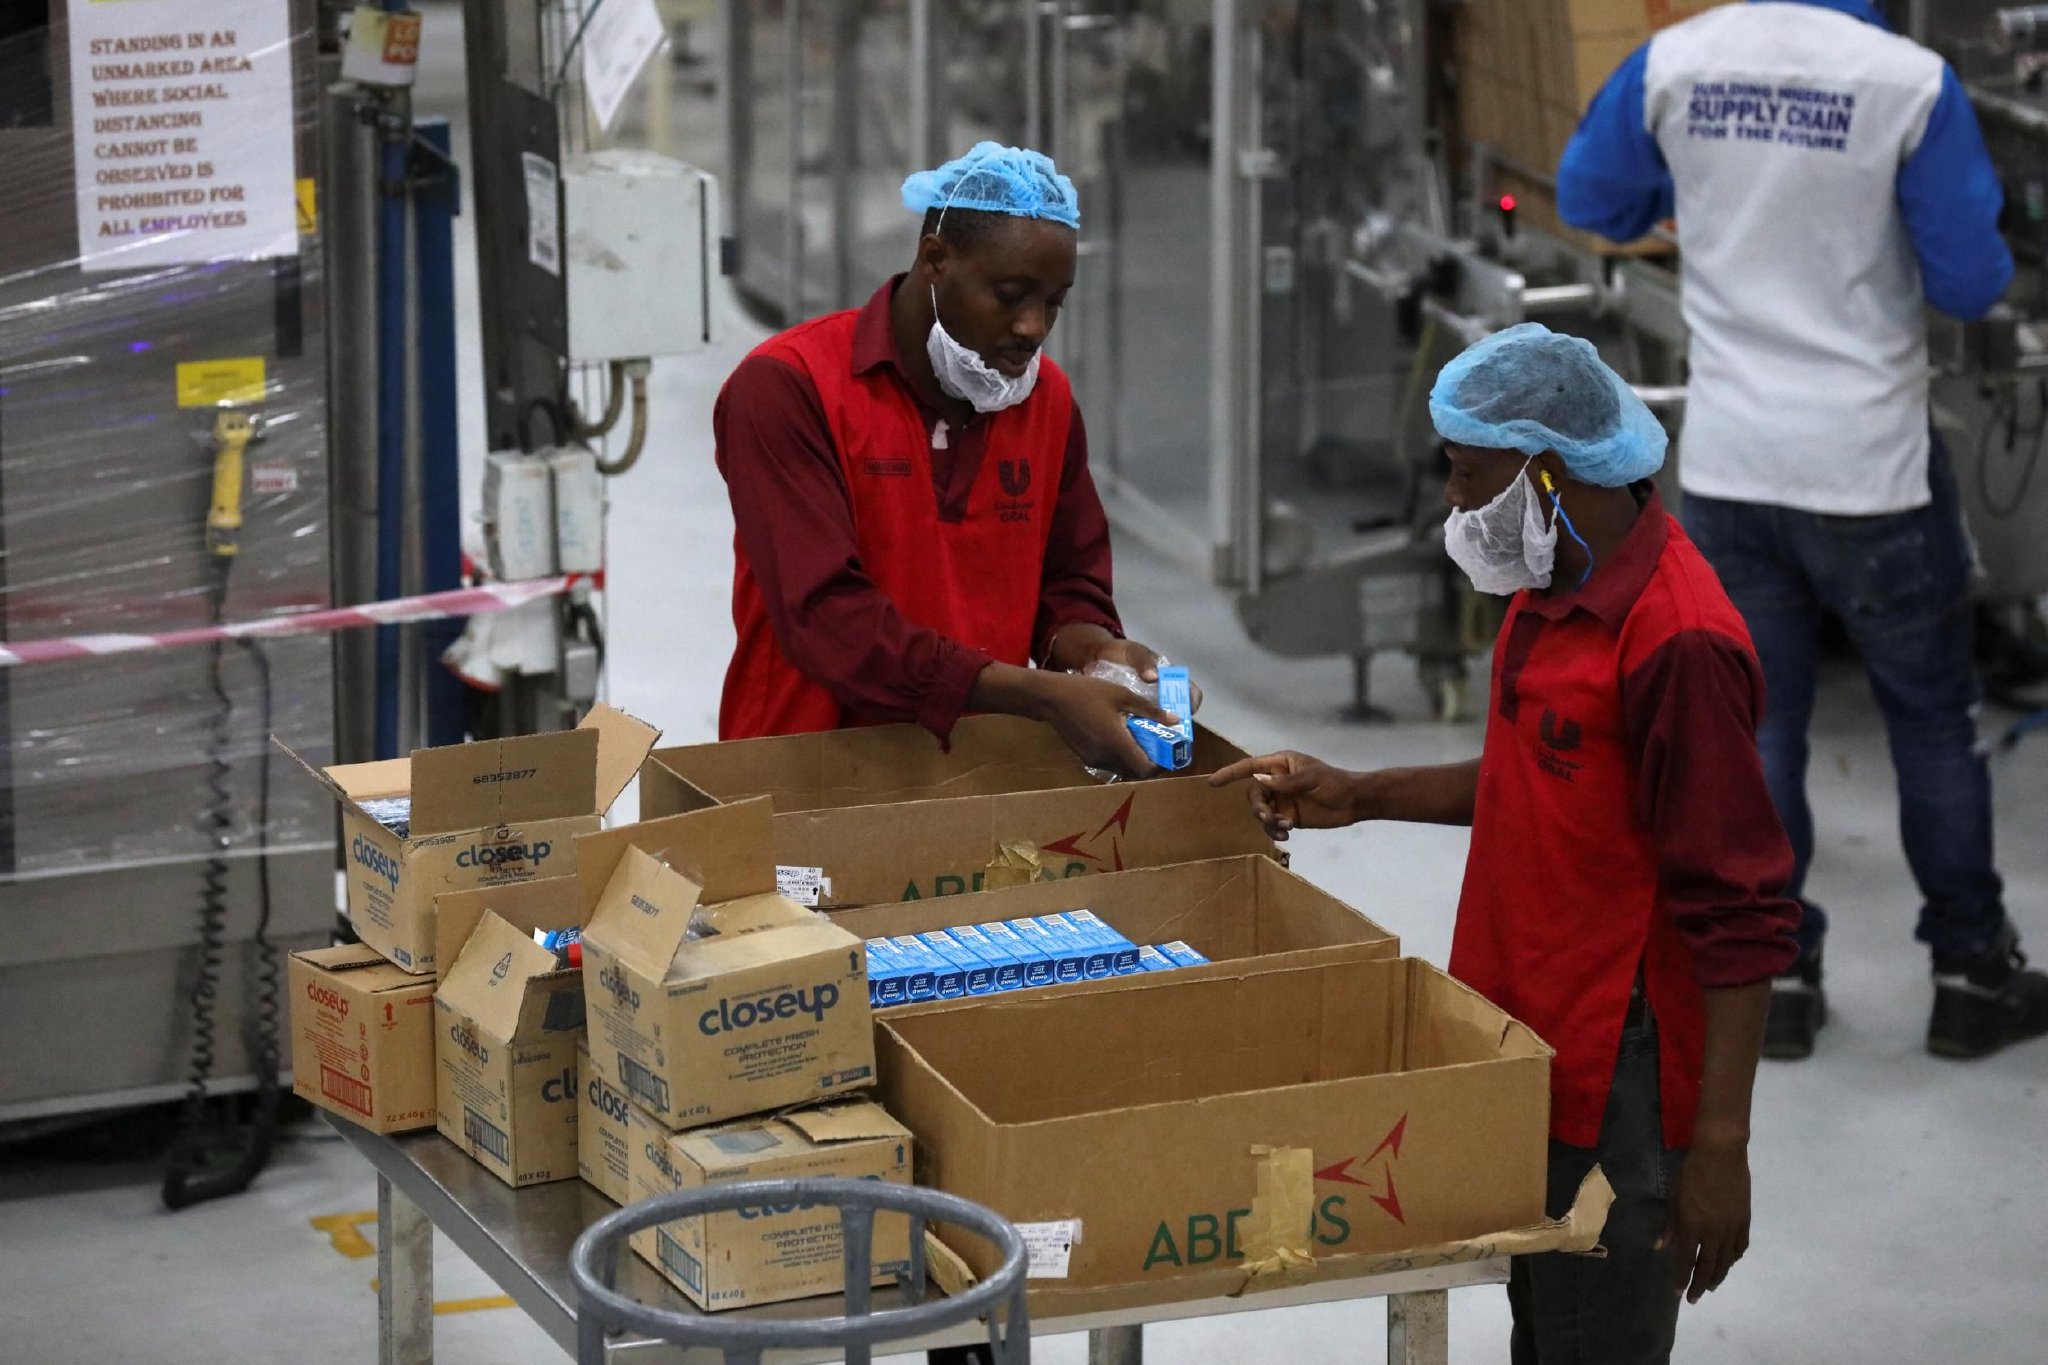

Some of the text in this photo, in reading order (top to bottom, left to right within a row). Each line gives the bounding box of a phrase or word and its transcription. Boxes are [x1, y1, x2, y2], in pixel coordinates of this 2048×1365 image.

[90, 30, 236, 55] STANDING IN AN
[92, 56, 252, 80] UNMARKED AREA
[92, 83, 228, 107] WHERE SOCIAL
[94, 111, 202, 133] DISTANCING
[1689, 99, 1852, 133] SUPPLY CHAIN
[95, 138, 198, 159] CANNOT BE
[1688, 126, 1847, 151] FOR THE FUTURE
[96, 161, 213, 185] OBSERVED IS
[98, 185, 244, 211] PROHIBITED FOR
[98, 211, 246, 237] ALL EMPLOYEES
[1133, 719, 1175, 739] closeup
[473, 768, 537, 784] 68353877
[353, 832, 399, 893] closeup
[456, 840, 550, 868] closeup
[307, 980, 350, 1021] closeup
[698, 983, 839, 1035] closeup
[451, 1023, 488, 1068] closeup
[724, 1029, 820, 1057] COMPLETE FRESH
[739, 1041, 807, 1063] PROTECTION
[541, 1068, 578, 1103] cl
[646, 1142, 682, 1190] closeup
[762, 1225, 822, 1242] COMPLETE
[1143, 1196, 1350, 1271] ABDS
